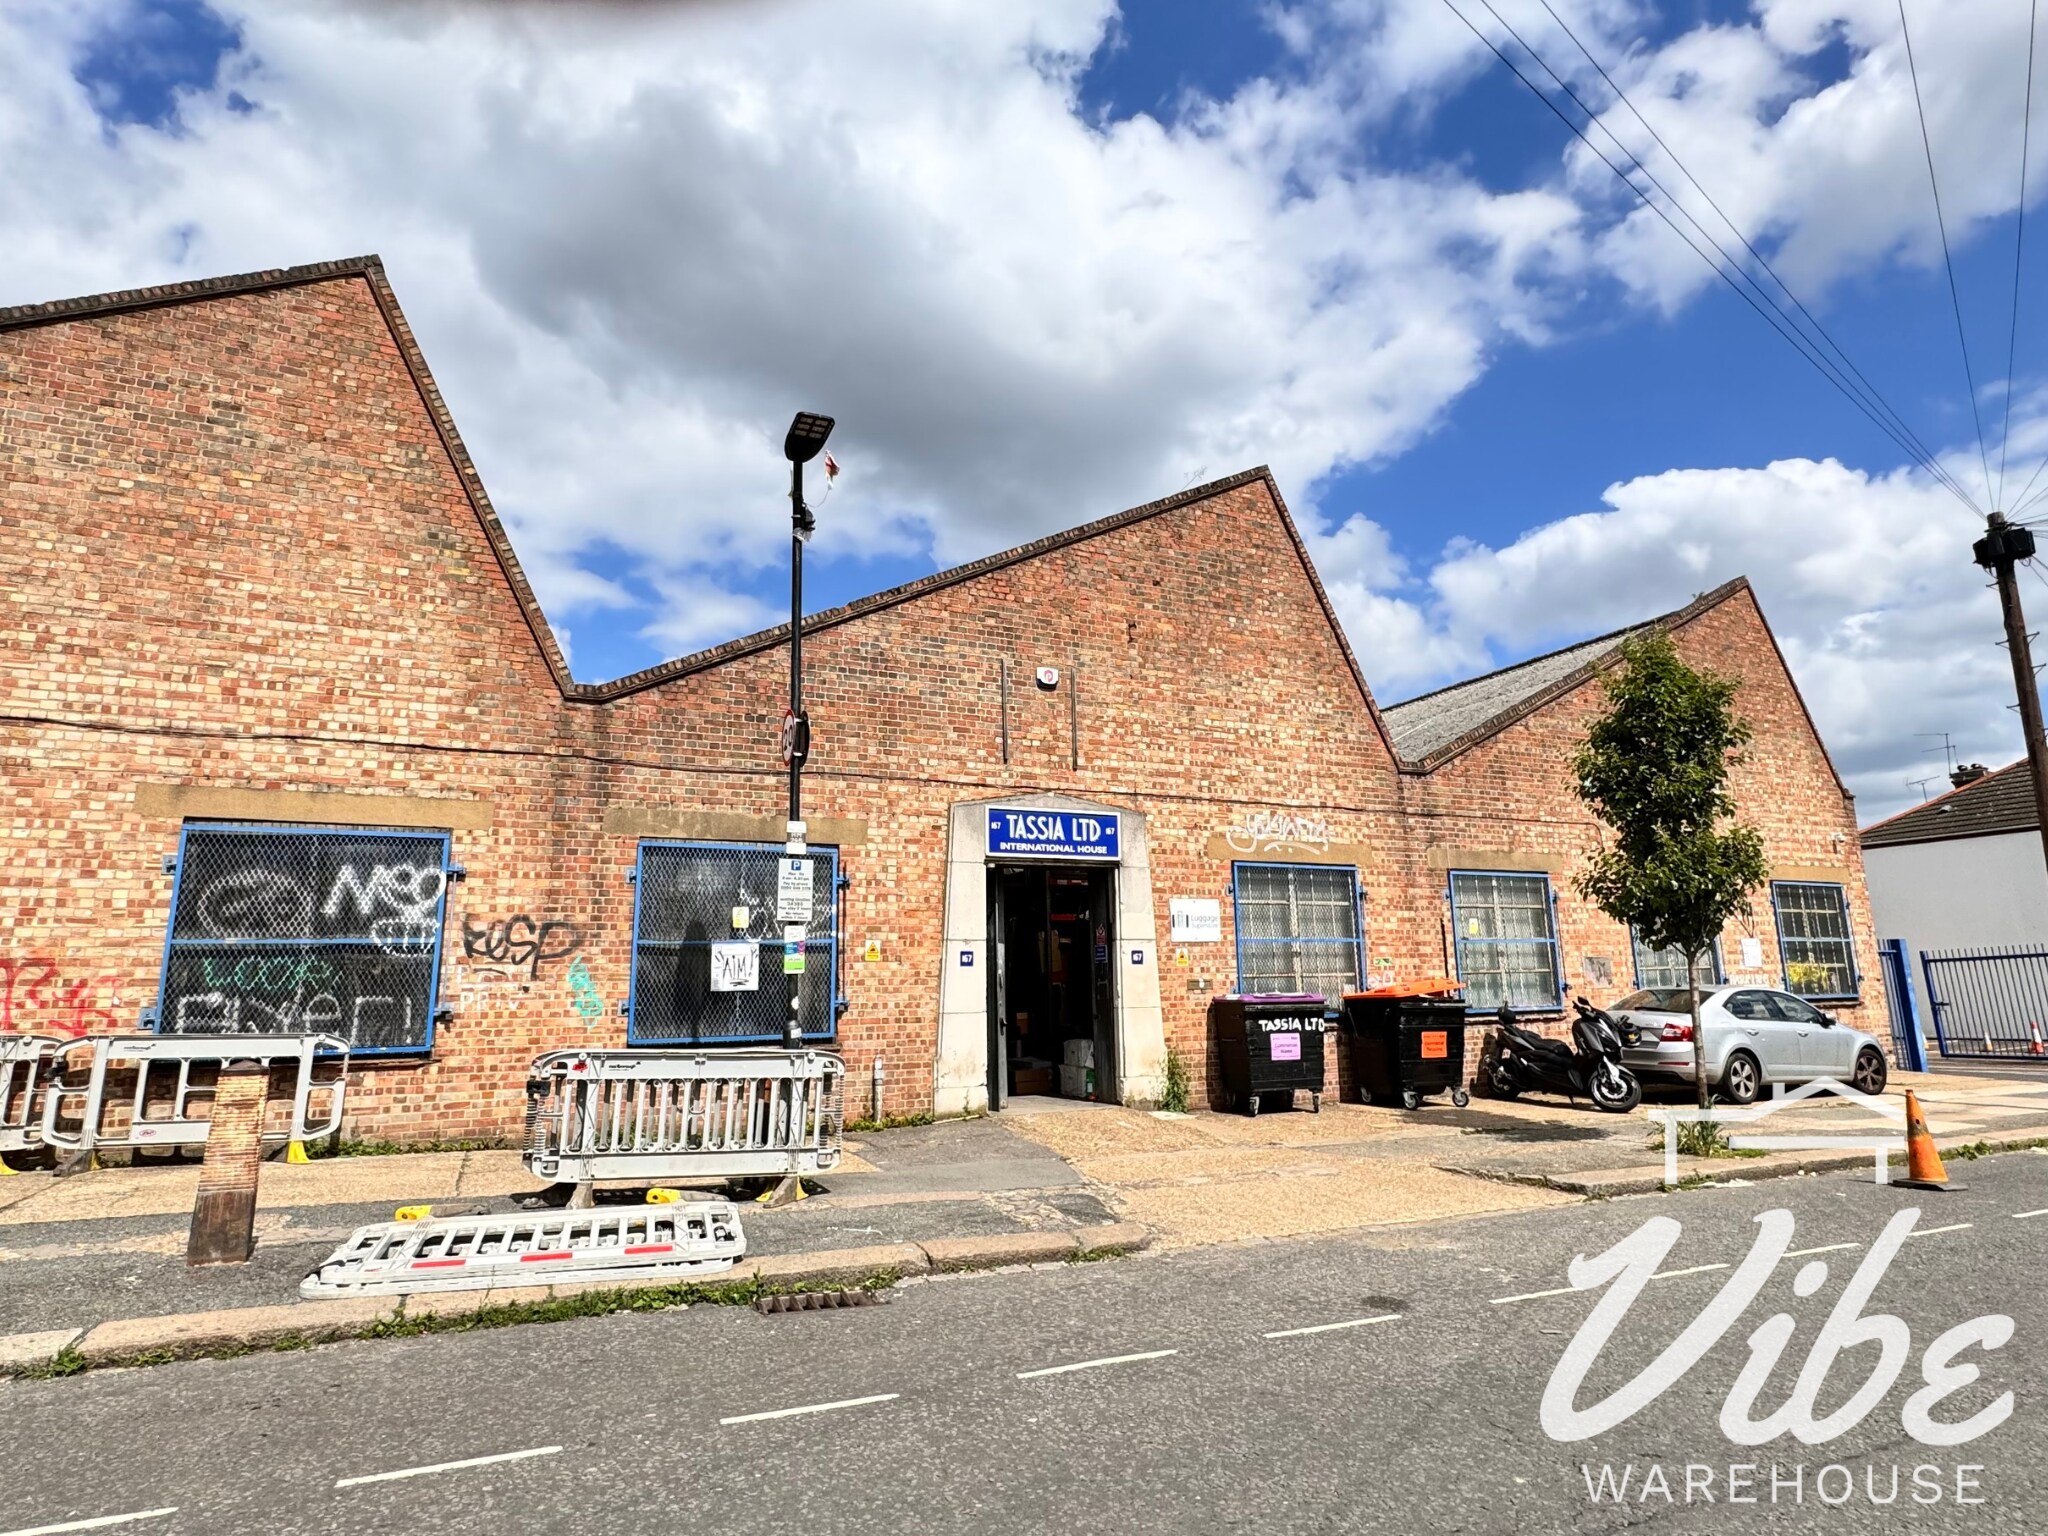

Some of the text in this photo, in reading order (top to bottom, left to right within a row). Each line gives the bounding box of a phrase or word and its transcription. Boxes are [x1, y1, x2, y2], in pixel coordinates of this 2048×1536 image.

[784, 724, 793, 752] 20
[1006, 814, 1101, 842] TASSIA LTD
[1000, 842, 1107, 854] INTERNATIONAL HOUSE
[1191, 914, 1218, 923] Luggage
[1258, 1017, 1325, 1032] TASSIA LTD
